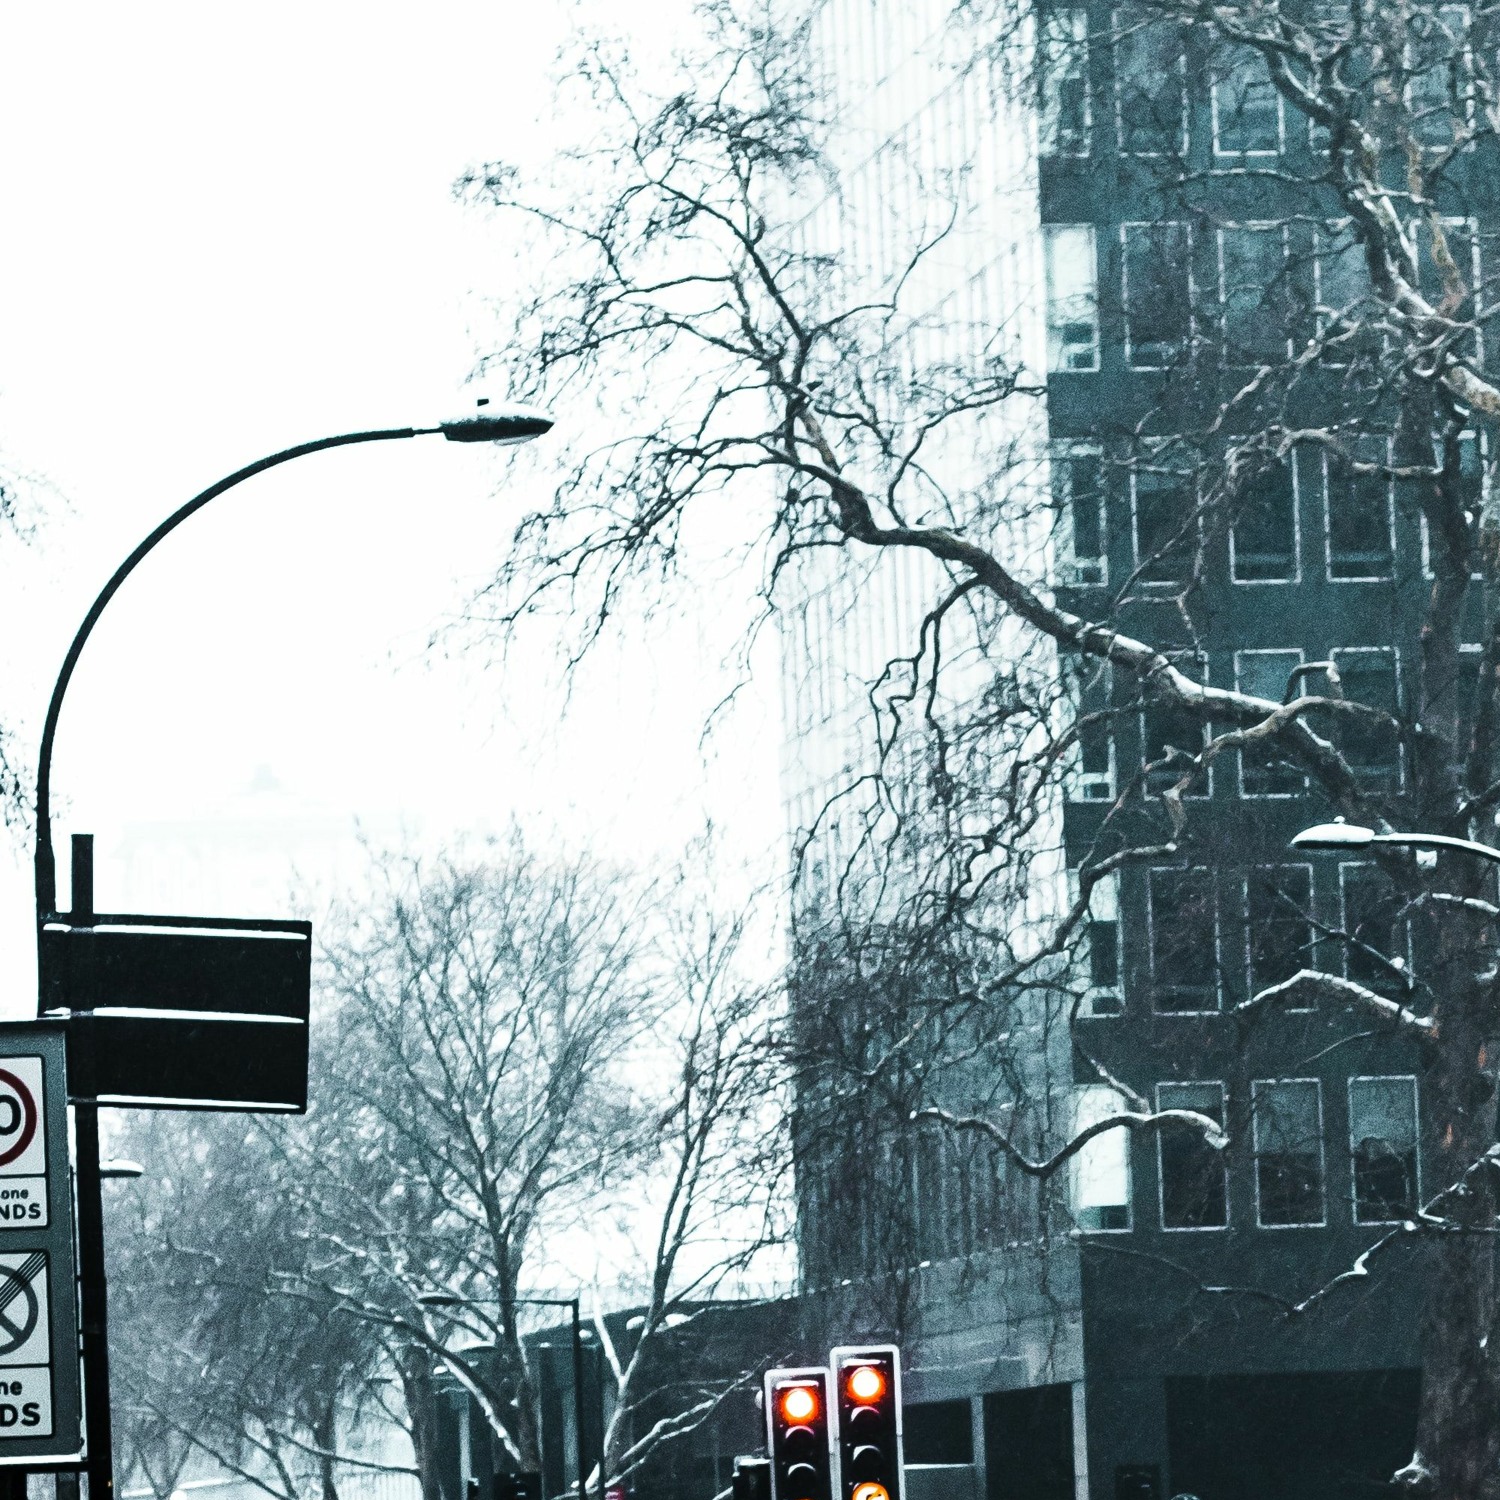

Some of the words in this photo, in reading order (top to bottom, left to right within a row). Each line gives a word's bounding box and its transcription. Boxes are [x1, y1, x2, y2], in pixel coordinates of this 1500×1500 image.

[0, 1095, 21, 1135] 0
[0, 1189, 29, 1199] one
[0, 1203, 41, 1220] NDS
